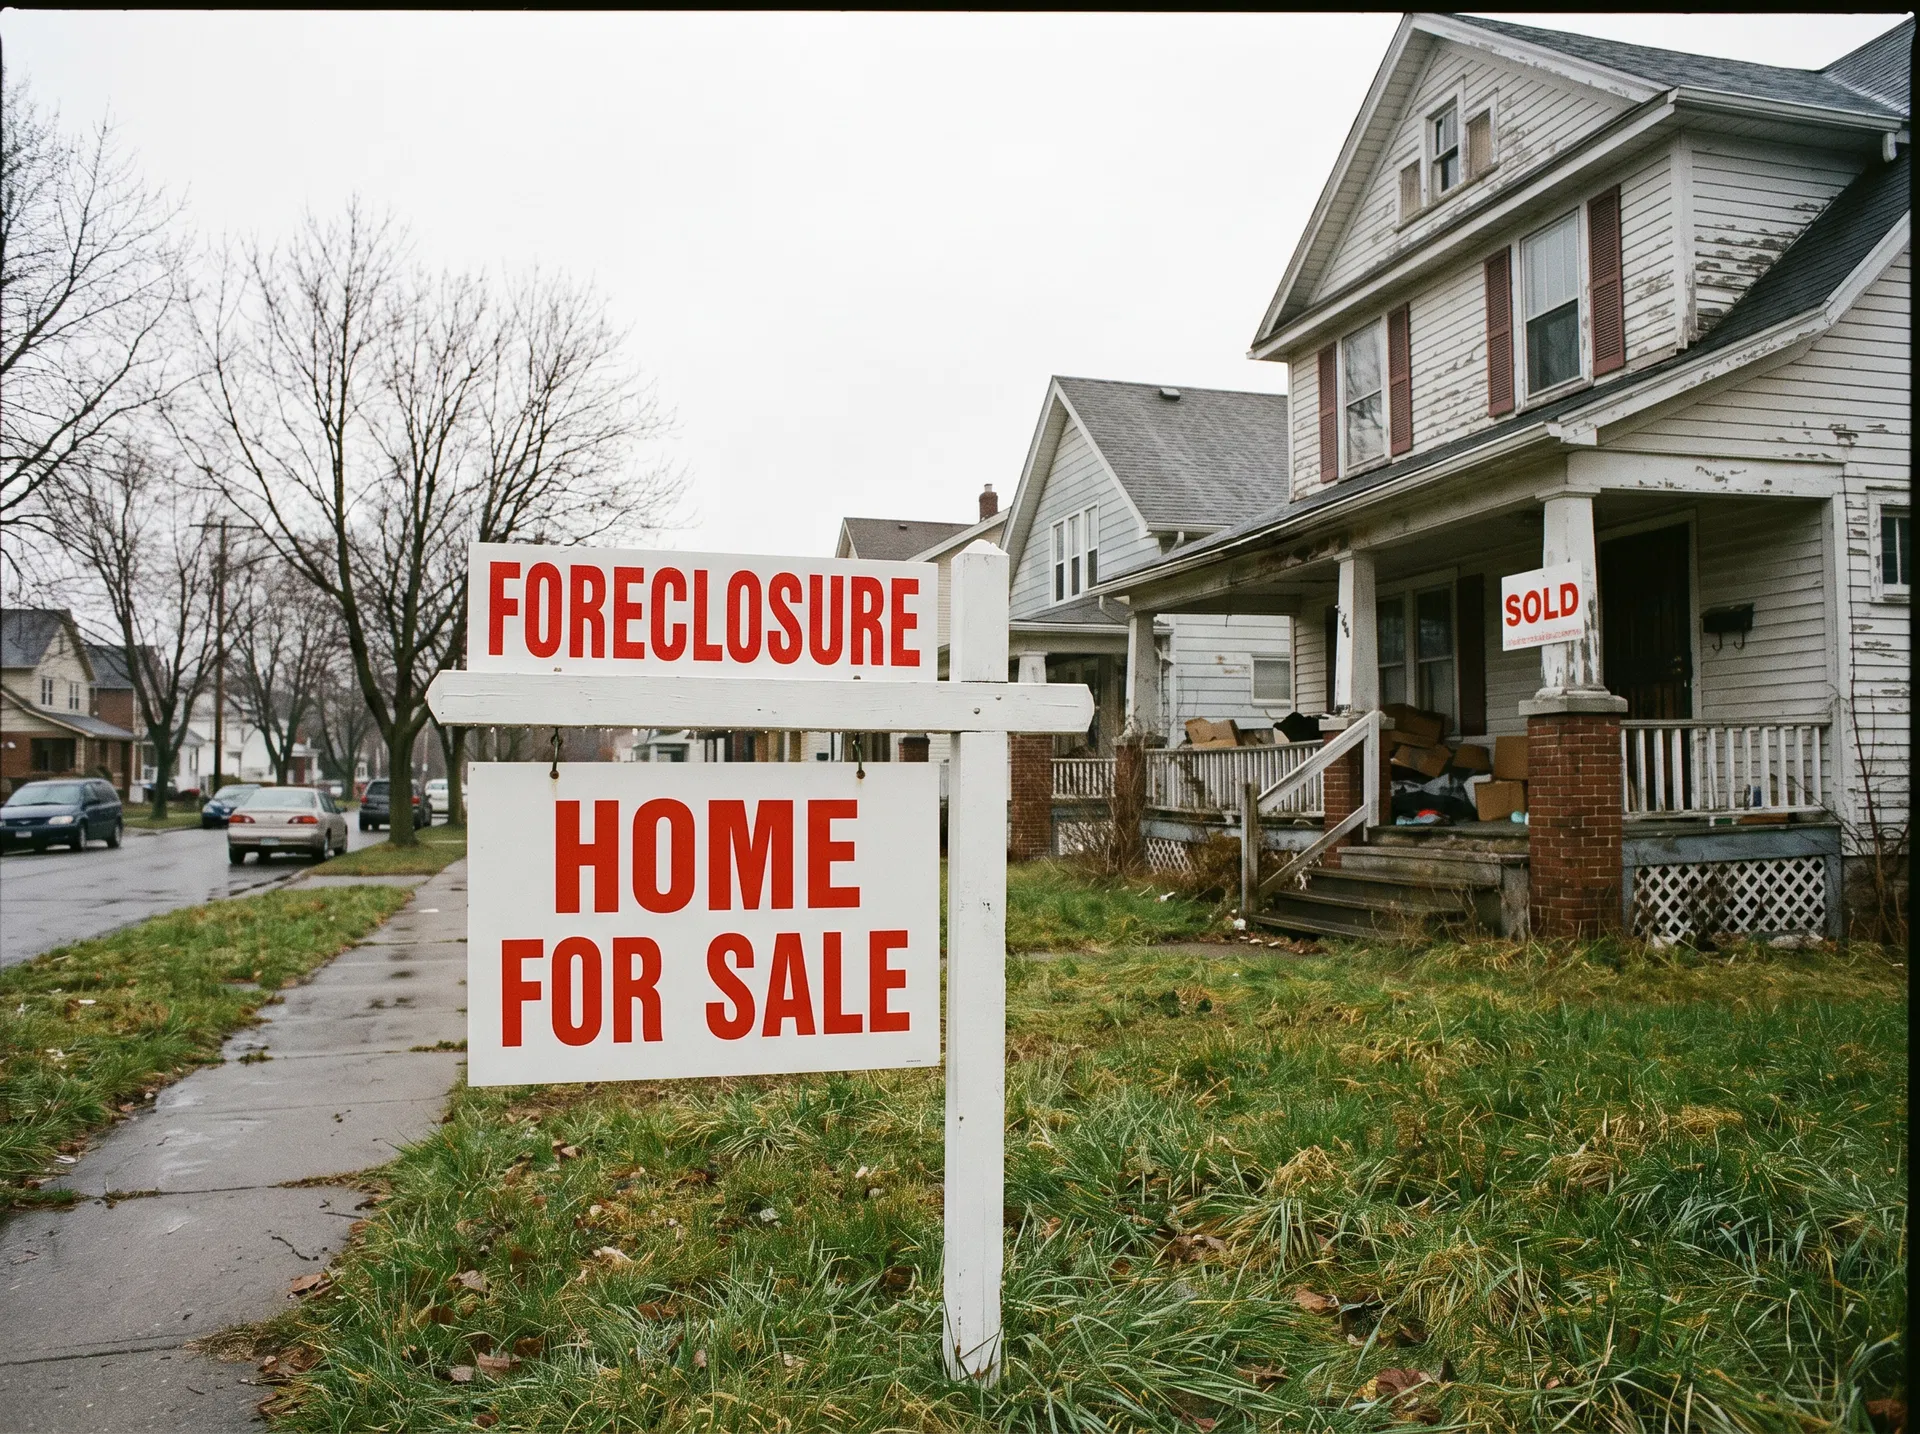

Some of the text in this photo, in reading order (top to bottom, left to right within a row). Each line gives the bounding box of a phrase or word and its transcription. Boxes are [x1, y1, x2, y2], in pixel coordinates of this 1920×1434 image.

[488, 561, 921, 668] FORECLOSURE
[1505, 582, 1579, 627] SOLD
[554, 797, 861, 915] HOME
[501, 929, 911, 1047] FOR SALE
